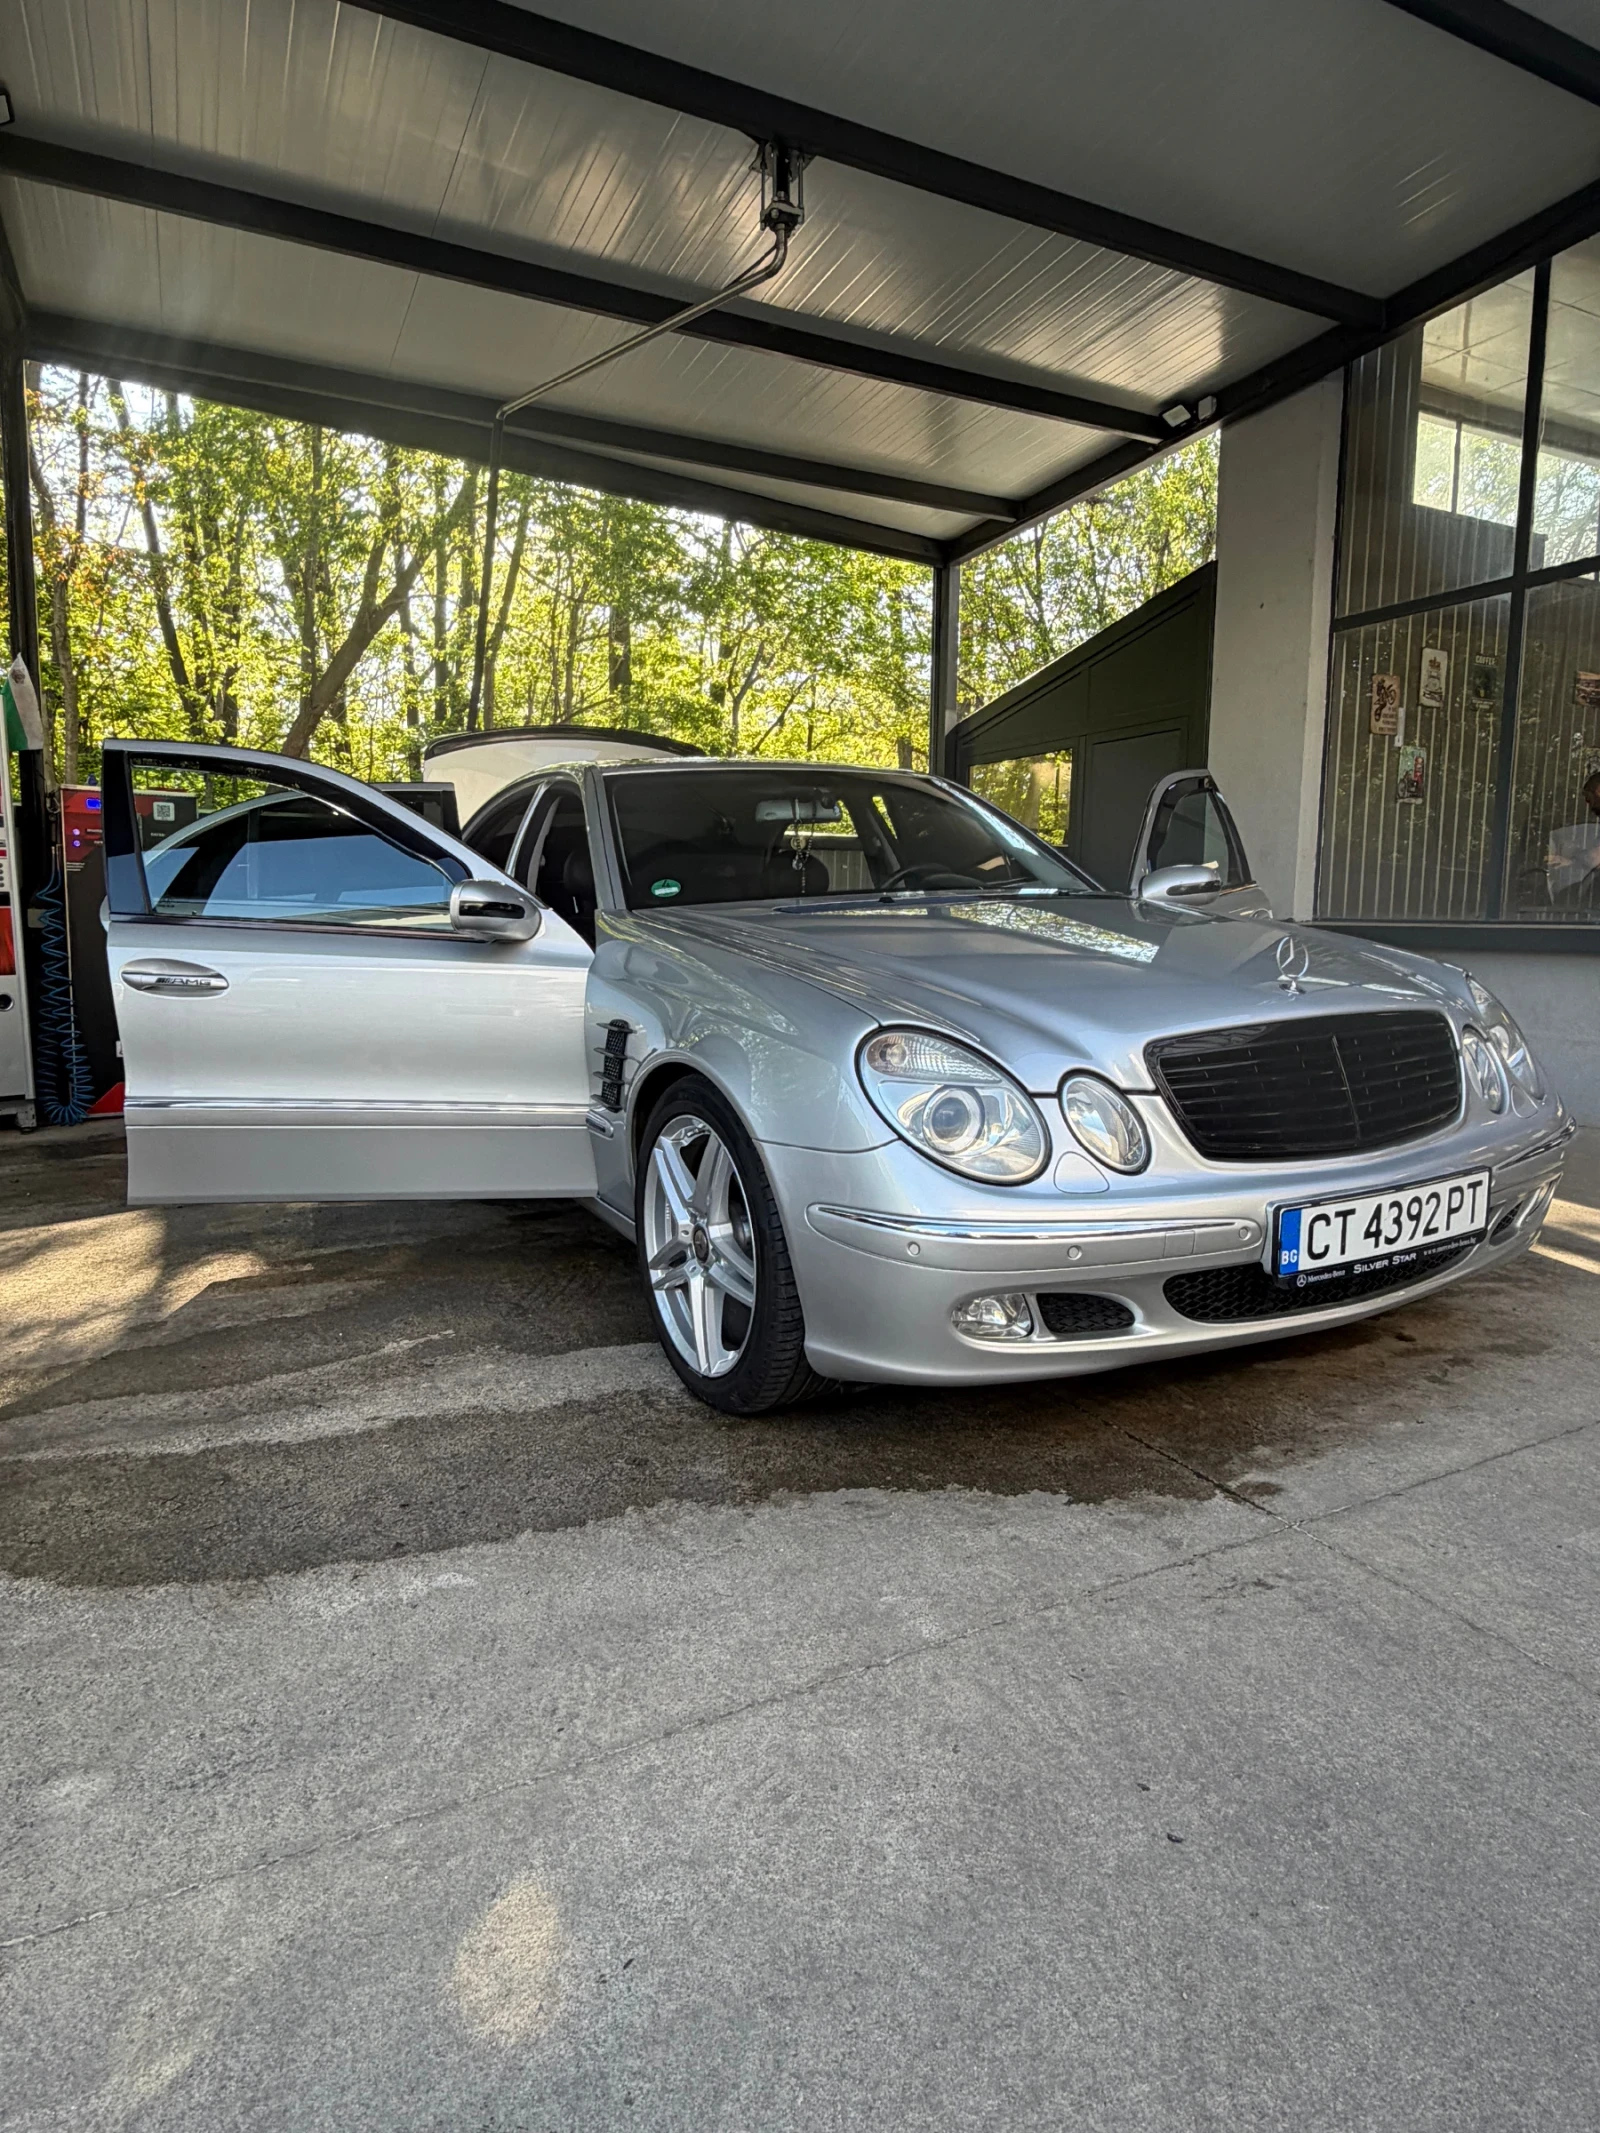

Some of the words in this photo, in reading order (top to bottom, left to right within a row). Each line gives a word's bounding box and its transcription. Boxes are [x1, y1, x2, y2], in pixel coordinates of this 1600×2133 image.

[172, 977, 211, 986] AMG
[1307, 1208, 1356, 1260] CT
[1363, 1192, 1441, 1248] 4392
[1446, 1180, 1483, 1231] PT
[1281, 1248, 1298, 1265] BG
[1307, 1269, 1346, 1283] Mercedes-Benz
